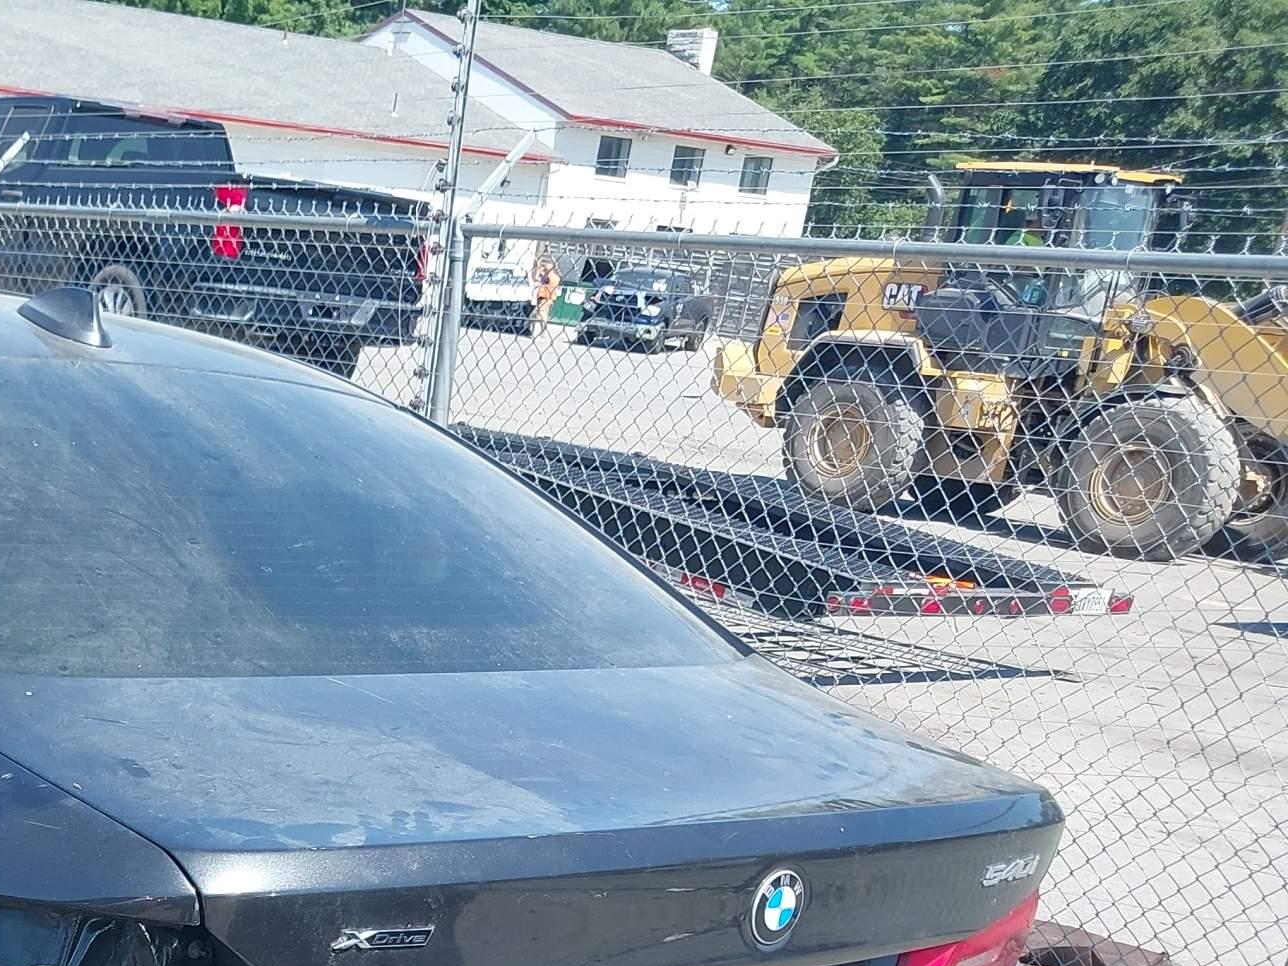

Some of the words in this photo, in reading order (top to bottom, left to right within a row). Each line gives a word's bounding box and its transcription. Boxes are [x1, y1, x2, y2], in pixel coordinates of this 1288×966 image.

[885, 283, 922, 311] CAT
[982, 855, 1040, 887] 540i
[763, 874, 802, 898] BMW
